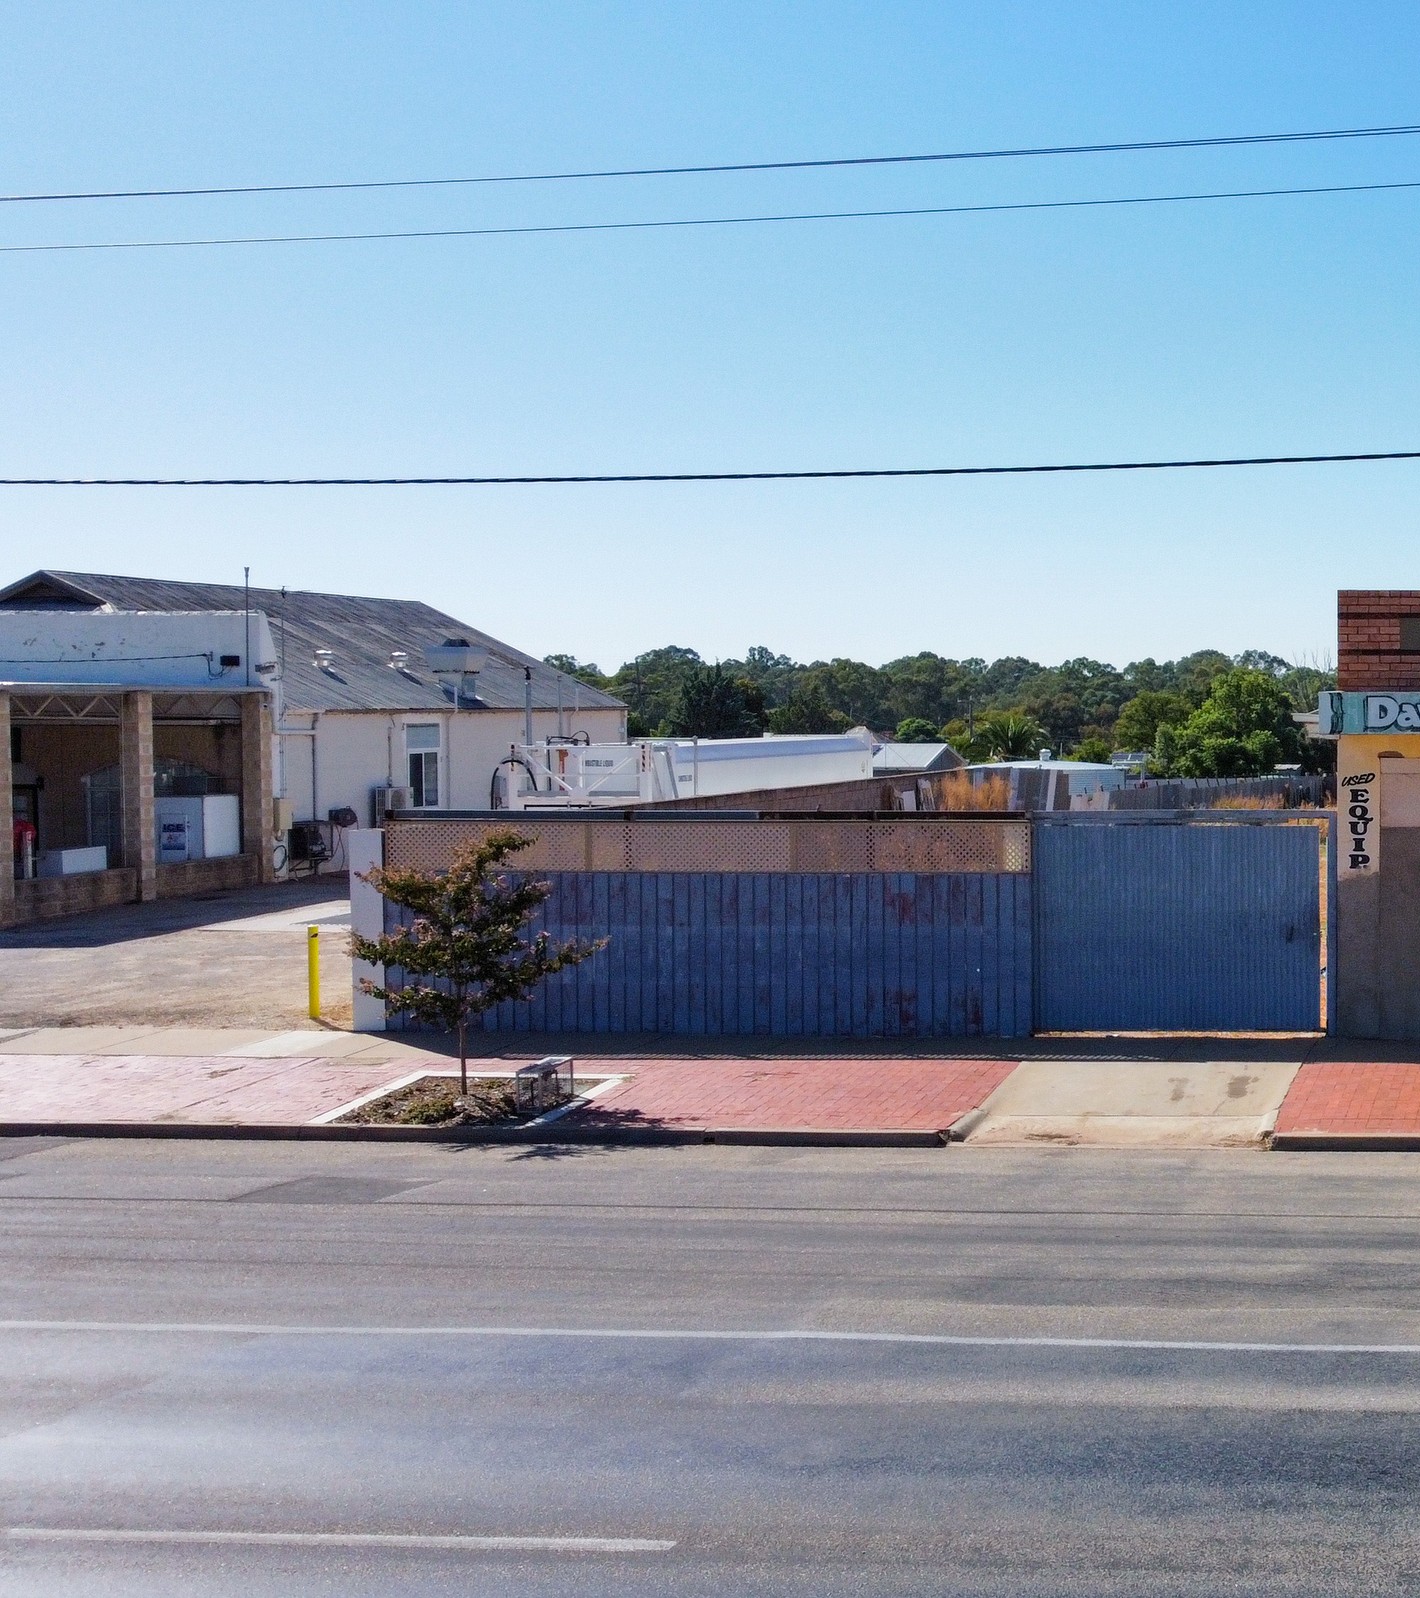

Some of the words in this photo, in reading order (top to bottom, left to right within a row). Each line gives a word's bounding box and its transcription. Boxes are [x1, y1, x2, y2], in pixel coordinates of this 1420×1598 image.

[1341, 773, 1376, 787] USED
[162, 823, 185, 832] ICE
[1348, 788, 1374, 870] EQUIP
